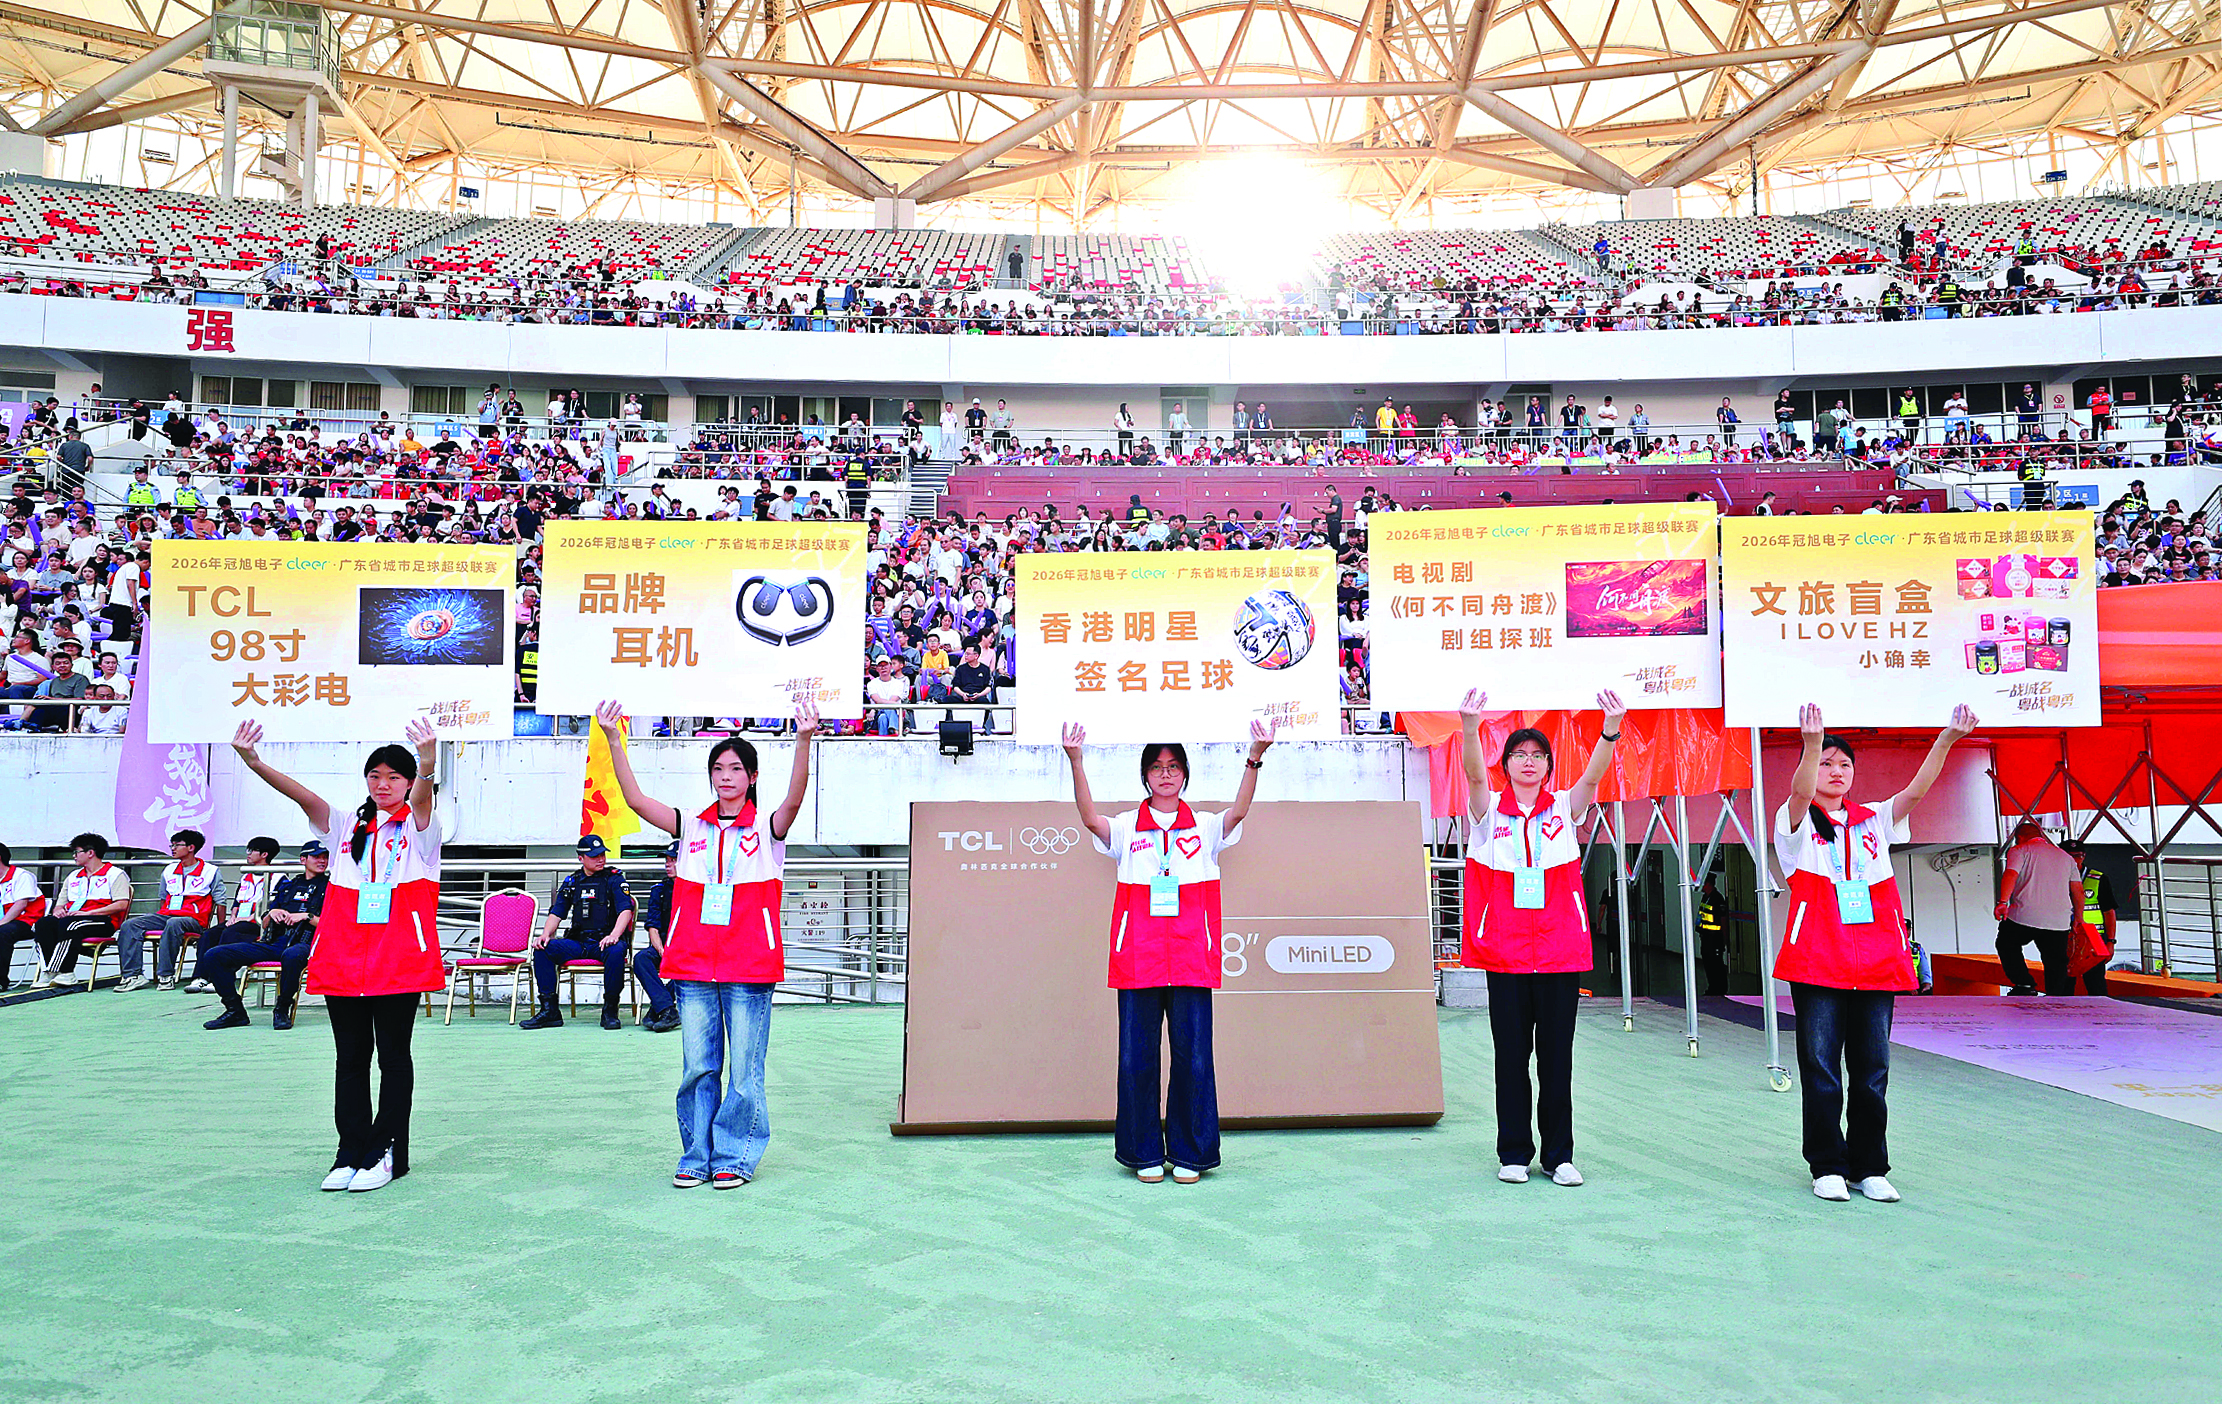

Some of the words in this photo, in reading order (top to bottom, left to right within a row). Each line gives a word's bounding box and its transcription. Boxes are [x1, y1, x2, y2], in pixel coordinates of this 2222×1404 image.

[187, 308, 235, 353] 强
[560, 536, 656, 550] 2026年冠旭电子
[658, 535, 696, 550] cleer
[1386, 526, 1488, 541] 2026年冠旭电子
[1491, 523, 1532, 538] cleer
[1741, 533, 1850, 548] 2026年冠旭电子
[1854, 531, 1896, 546] cleer
[171, 557, 283, 571] 2026年冠旭电子
[286, 556, 330, 571] cleer
[1032, 568, 1127, 581] 2026年冠旭电子
[1131, 566, 1168, 580] cleer
[1393, 560, 1473, 584] 电视剧
[177, 585, 272, 618] TCL
[579, 571, 666, 615] 品牌
[1390, 591, 1557, 619] 《何不同舟渡》
[1749, 579, 1933, 617] 文旅盲盒
[1039, 610, 1199, 644] 香港明星
[1441, 626, 1553, 651] 剧组探班
[1798, 621, 1879, 640] LOVE
[1889, 621, 1929, 639] HZ
[210, 628, 307, 663] 98寸
[611, 625, 699, 668] 耳机
[1859, 649, 1931, 669] 小确幸
[1074, 658, 1234, 692] 签名足球
[232, 672, 351, 707] 大彩电
[937, 830, 1003, 852] TCL
[960, 862, 1058, 871] 奥林匹克全球合作伙伴
[1331, 945, 1372, 963] LED
